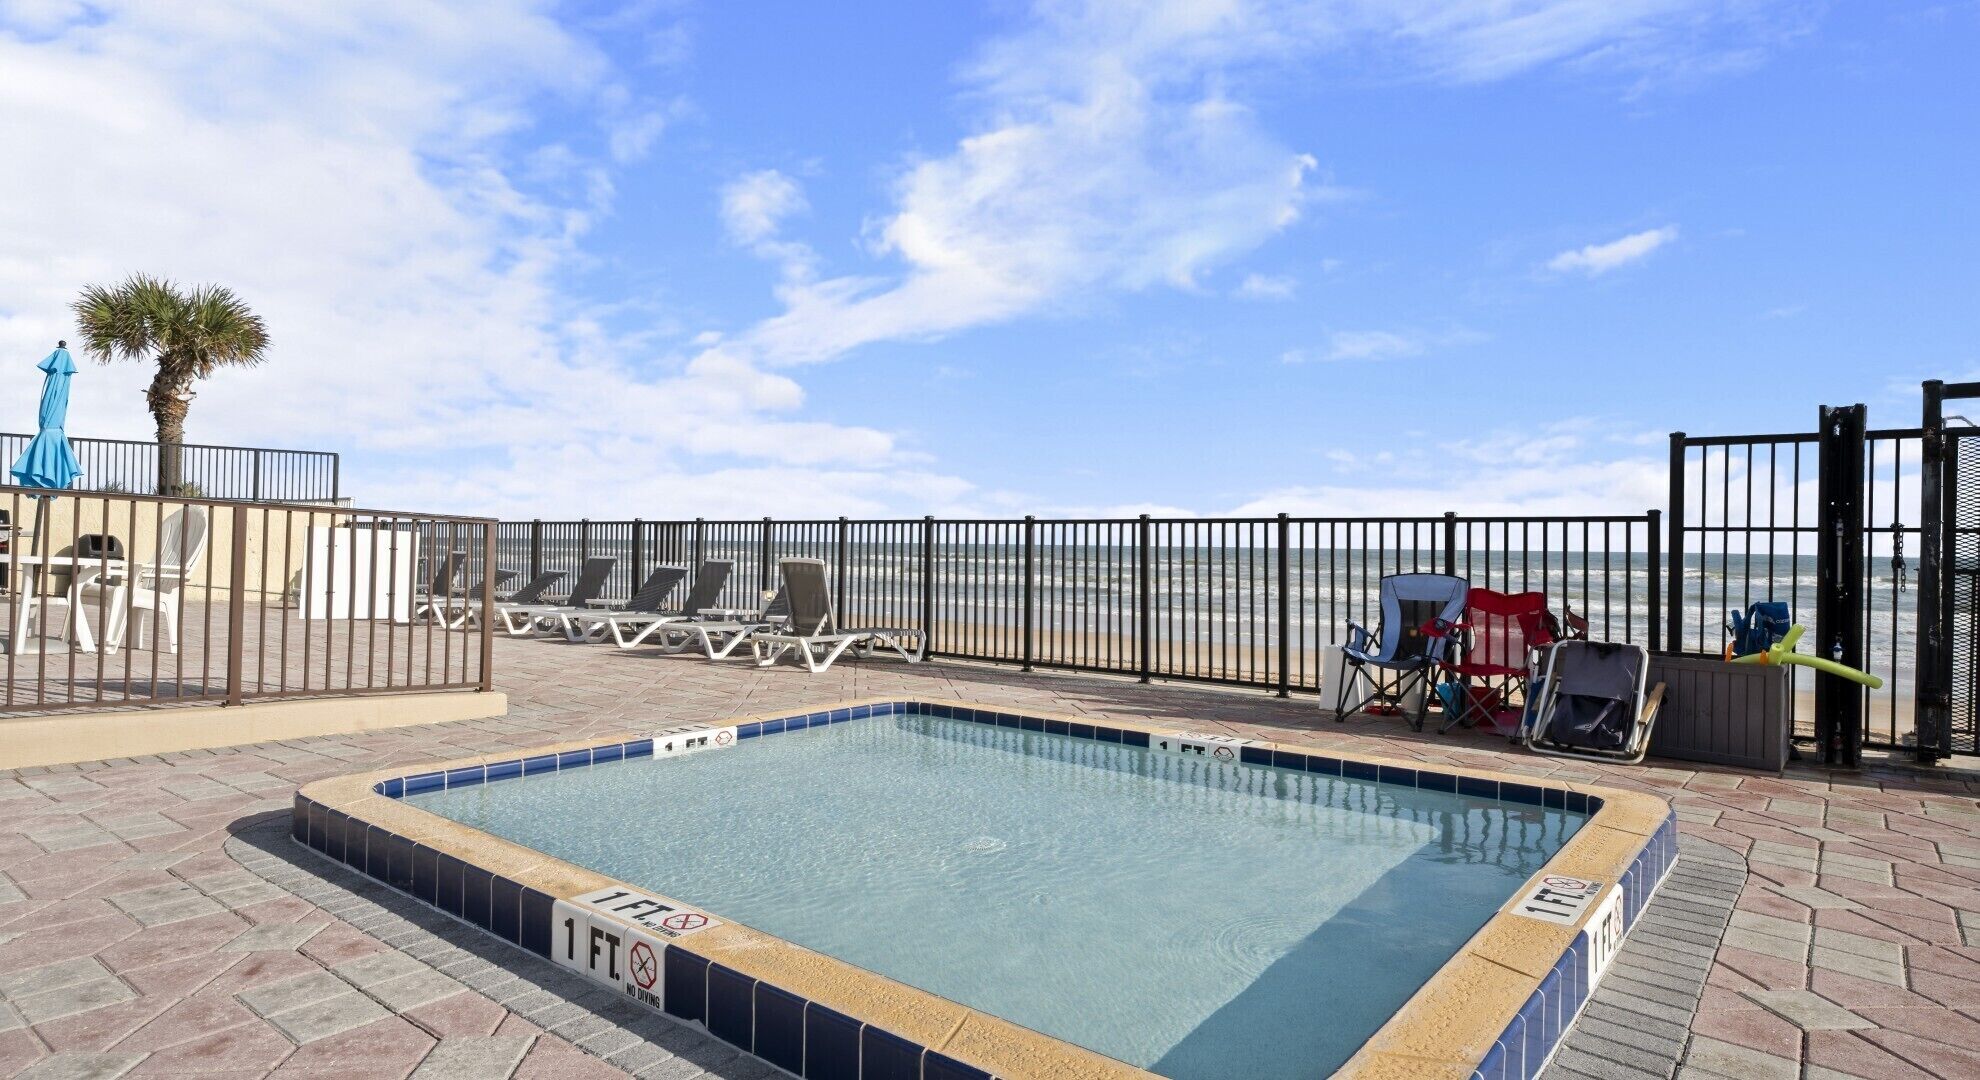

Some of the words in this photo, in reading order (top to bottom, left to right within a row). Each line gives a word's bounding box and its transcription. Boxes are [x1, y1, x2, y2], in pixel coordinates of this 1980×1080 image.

[592, 891, 630, 904] 1
[612, 899, 675, 921] FT.
[1525, 905, 1571, 918] 1
[564, 917, 575, 961] 1
[589, 925, 621, 981] FT.
[626, 982, 636, 997] NO
[637, 989, 661, 1009] DIVING
